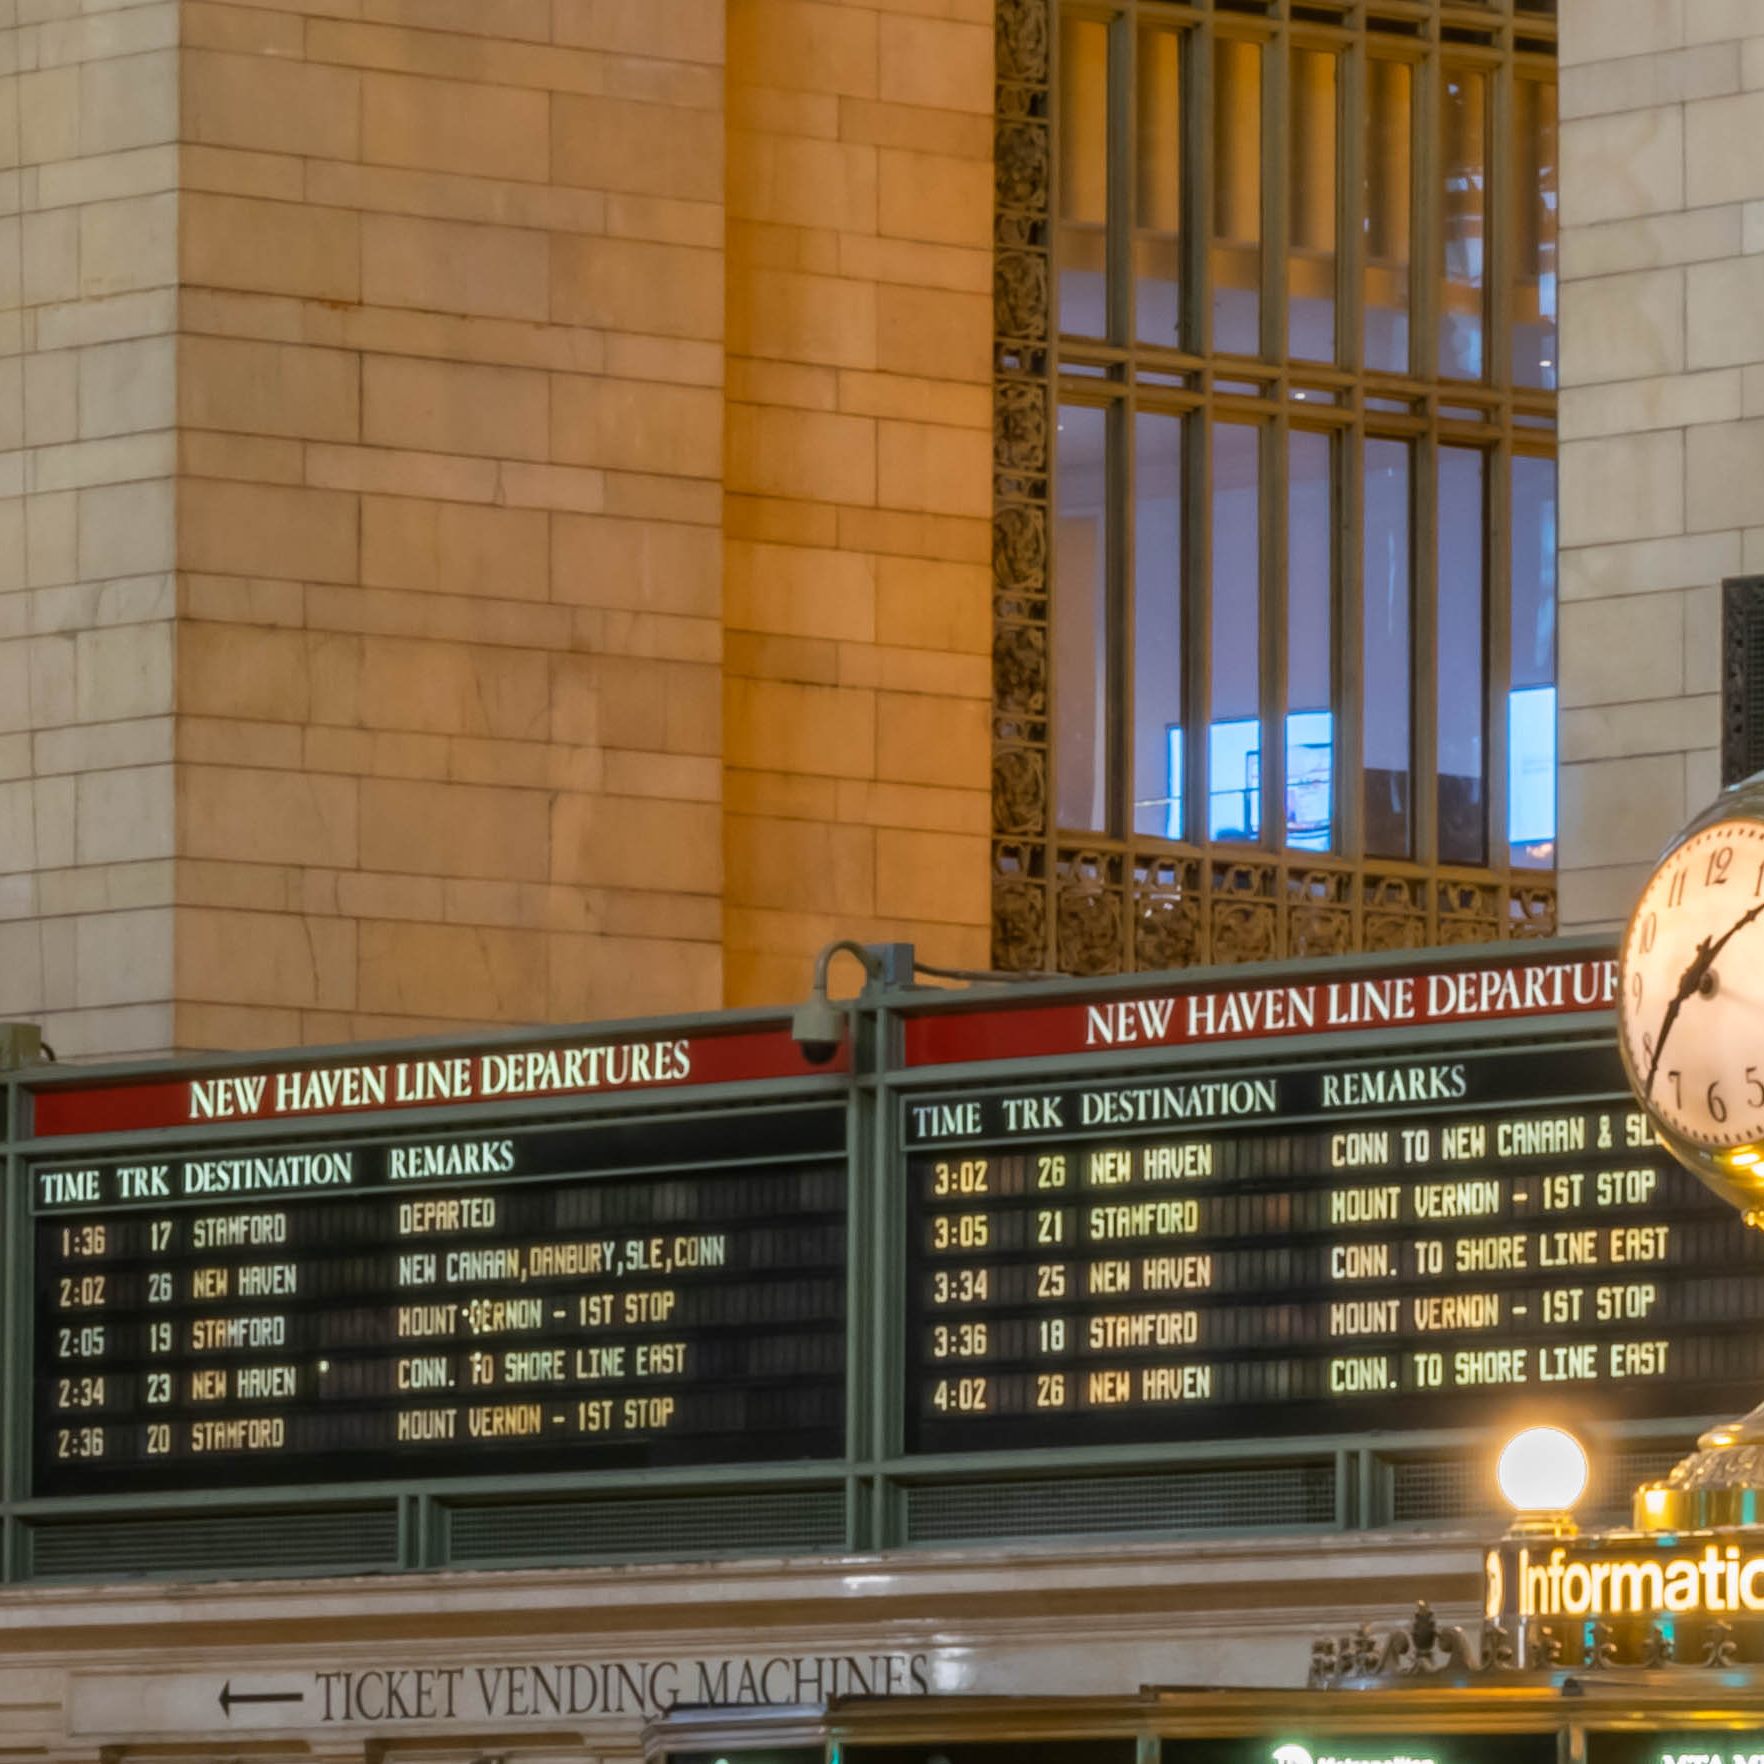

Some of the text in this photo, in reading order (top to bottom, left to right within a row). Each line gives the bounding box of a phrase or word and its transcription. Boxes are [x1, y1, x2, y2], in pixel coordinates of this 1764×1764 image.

[1705, 847, 1733, 886] 12
[1087, 979, 1414, 1044] NEW HAVEN LINE
[190, 1040, 689, 1118] NEW HAVEN LINE DEPARTURES
[914, 1066, 1465, 1136] TIME TRK DESTINATION REMARKS
[1707, 1081, 1727, 1123] 6
[41, 1141, 513, 1203] TIME TRK DESTINATION REMARKS
[935, 1117, 1584, 1194] 3:02 26 NEW HAVEN CONN TO NEW CANAAN
[63, 1198, 495, 1256] 1:36 17 STAMFORD DEPARTED
[935, 1170, 1655, 1248] 3:05 21 STAMFORD MOUNT VERNON 1ST STOP
[60, 1276, 105, 1307] 2:02
[149, 1273, 172, 1302] 26
[194, 1269, 227, 1298] NEW
[239, 1264, 296, 1295] HAVEN
[400, 1255, 435, 1285] NEW
[935, 1227, 1668, 1303] 3:34 25 NEW HAVEN CONN. TO SHORE LINE EAST
[60, 1291, 674, 1357] 2:05 19 STAMFORD MOUNT 1ST STOP
[59, 1344, 685, 1407] 2:34 23 NEW HAVEN CONN. SHORE LINE EAST
[934, 1342, 1668, 1410] 4:02 26 NEW HAVEN CONN. TO SHORE LINE EAST
[59, 1398, 674, 1458] 2:36 20 STAMFORD MOUNT VERNON 1ST STOP
[316, 1667, 464, 1721] TICKET
[477, 1658, 680, 1719] VENDING
